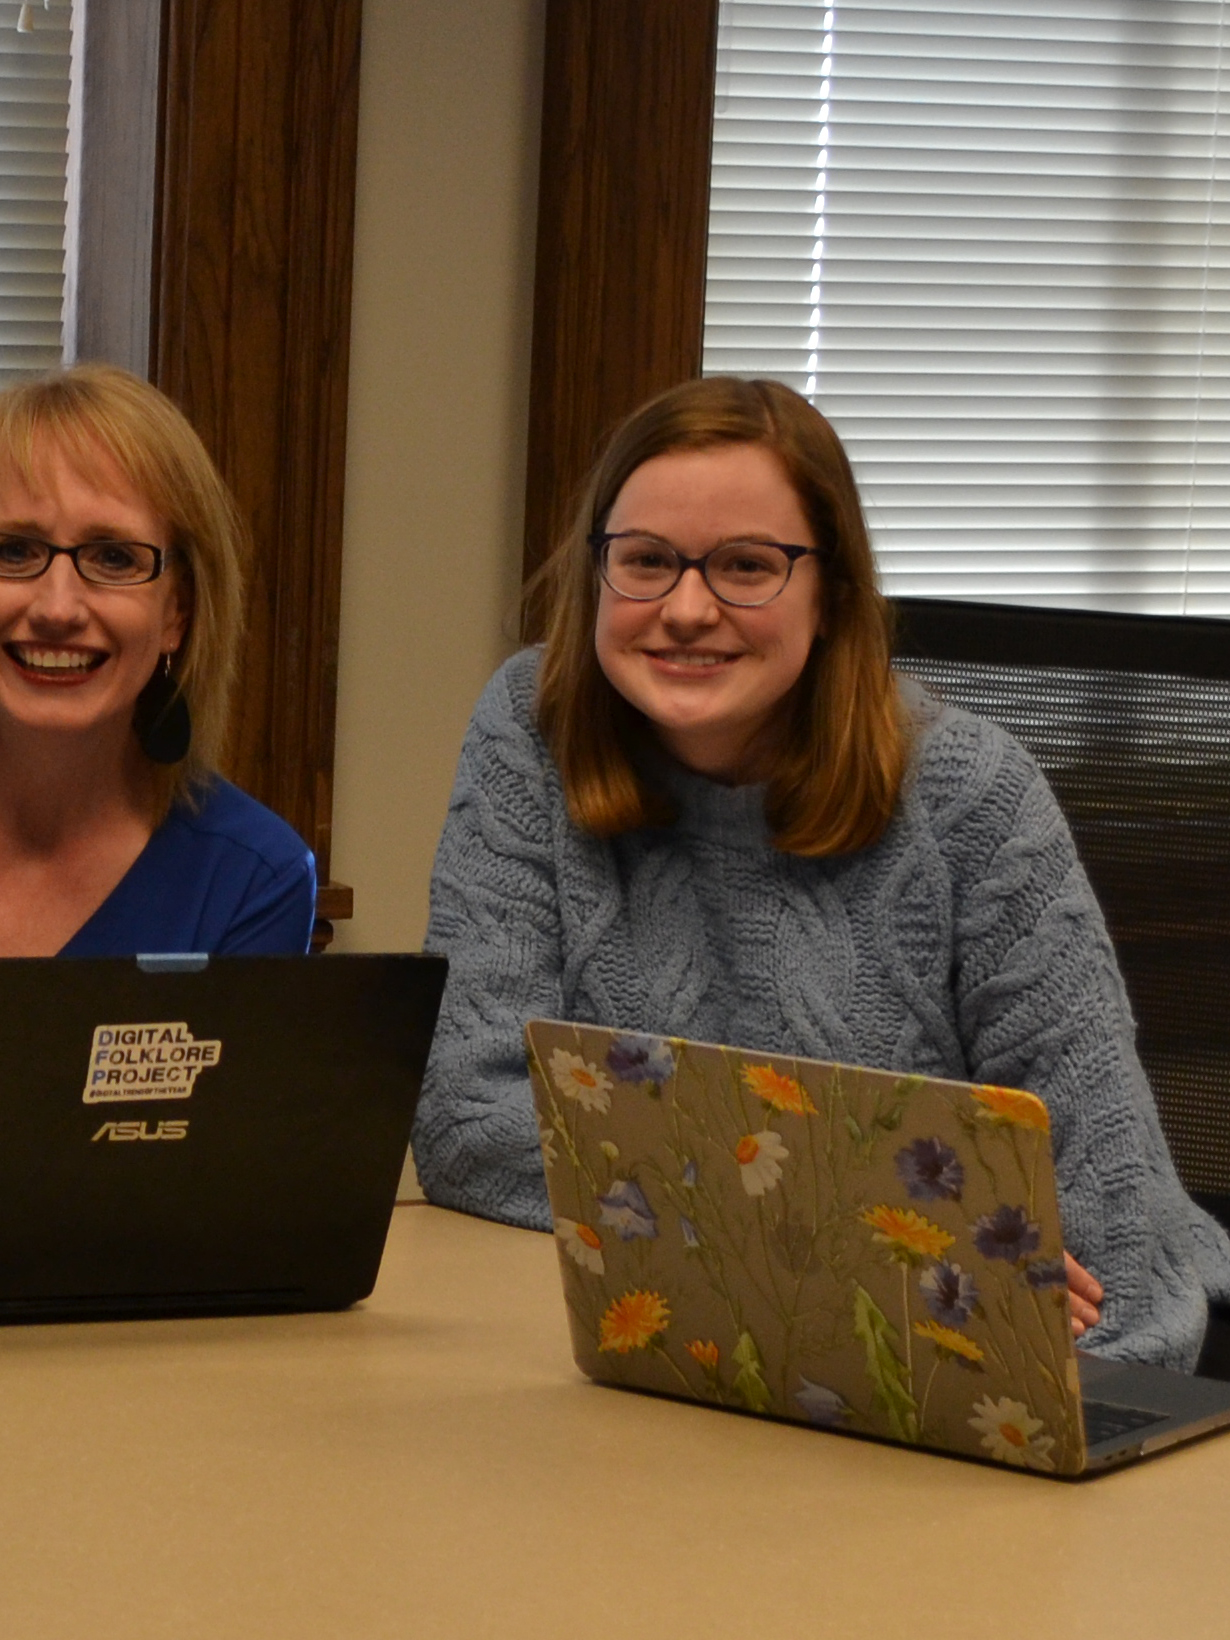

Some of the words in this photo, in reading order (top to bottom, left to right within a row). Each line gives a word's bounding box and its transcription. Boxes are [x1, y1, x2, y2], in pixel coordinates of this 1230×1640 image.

[98, 1028, 188, 1046] DIGITAL
[95, 1046, 216, 1065] FOLKLORE
[92, 1066, 197, 1085] PROJECT
[91, 1120, 189, 1142] ASUS
